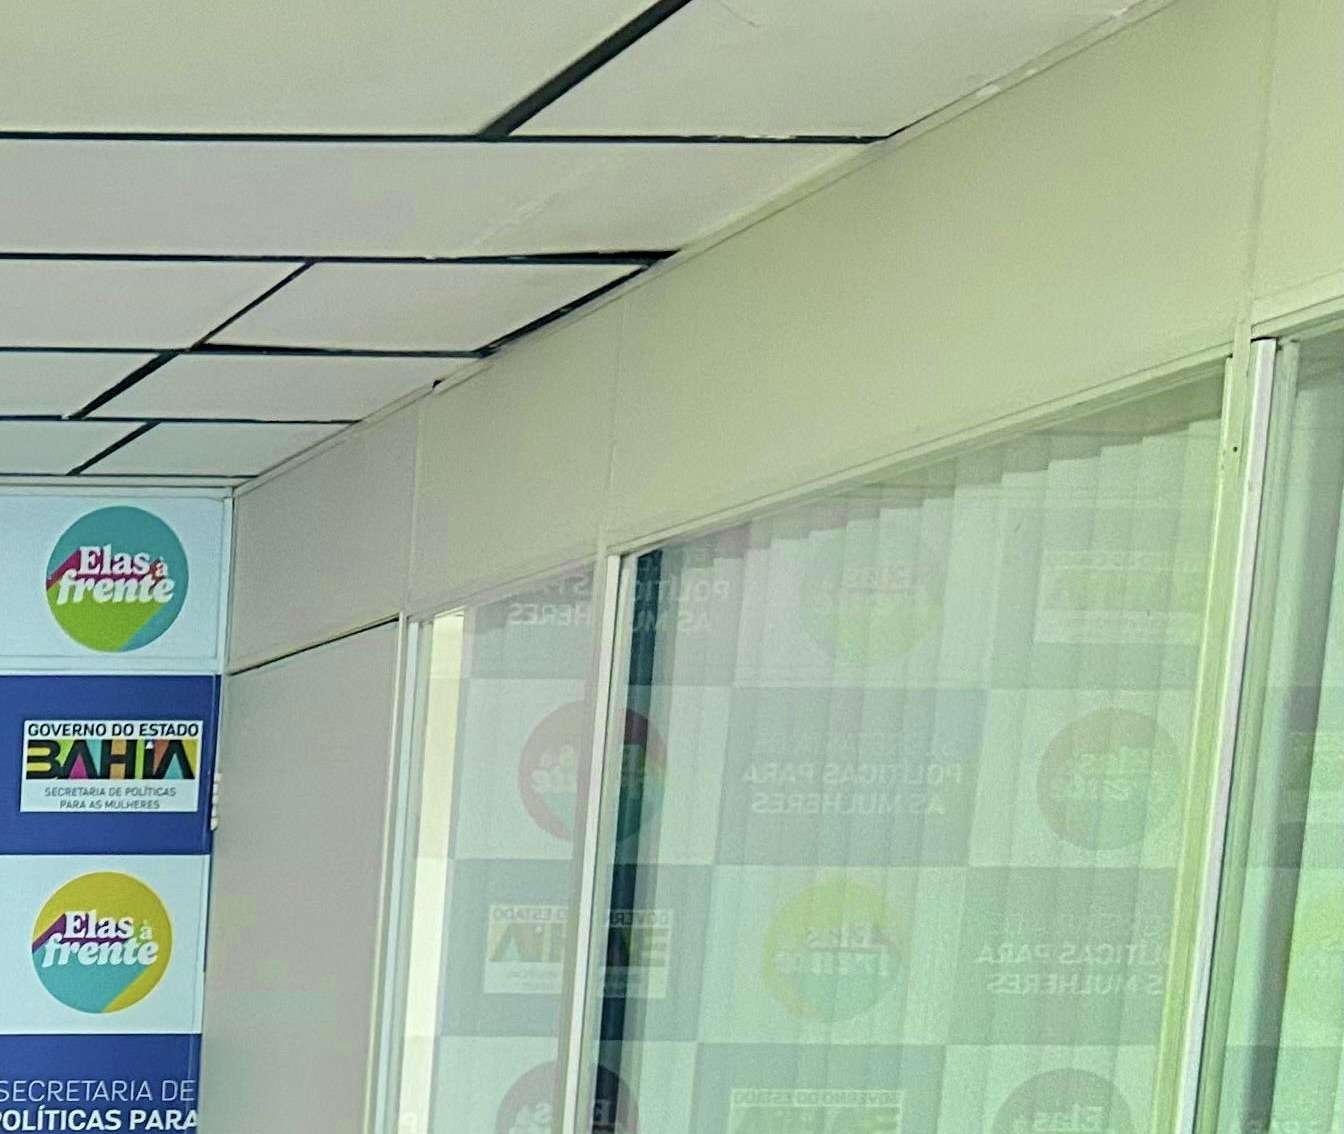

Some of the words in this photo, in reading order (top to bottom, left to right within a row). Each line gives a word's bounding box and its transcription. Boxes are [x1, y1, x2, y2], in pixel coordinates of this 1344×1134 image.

[77, 544, 151, 575] Elas
[56, 568, 176, 605] frente
[28, 723, 107, 737] GOVERNO
[112, 723, 134, 736] DO
[139, 723, 199, 736] ESTADO
[44, 787, 106, 797] SECRETARIA
[109, 787, 122, 797] DE
[59, 801, 86, 809] PARA
[89, 801, 102, 809] AS
[105, 800, 159, 810] MULHERES
[163, 1080, 195, 1101] DE
[129, 1110, 198, 1131] PARA
